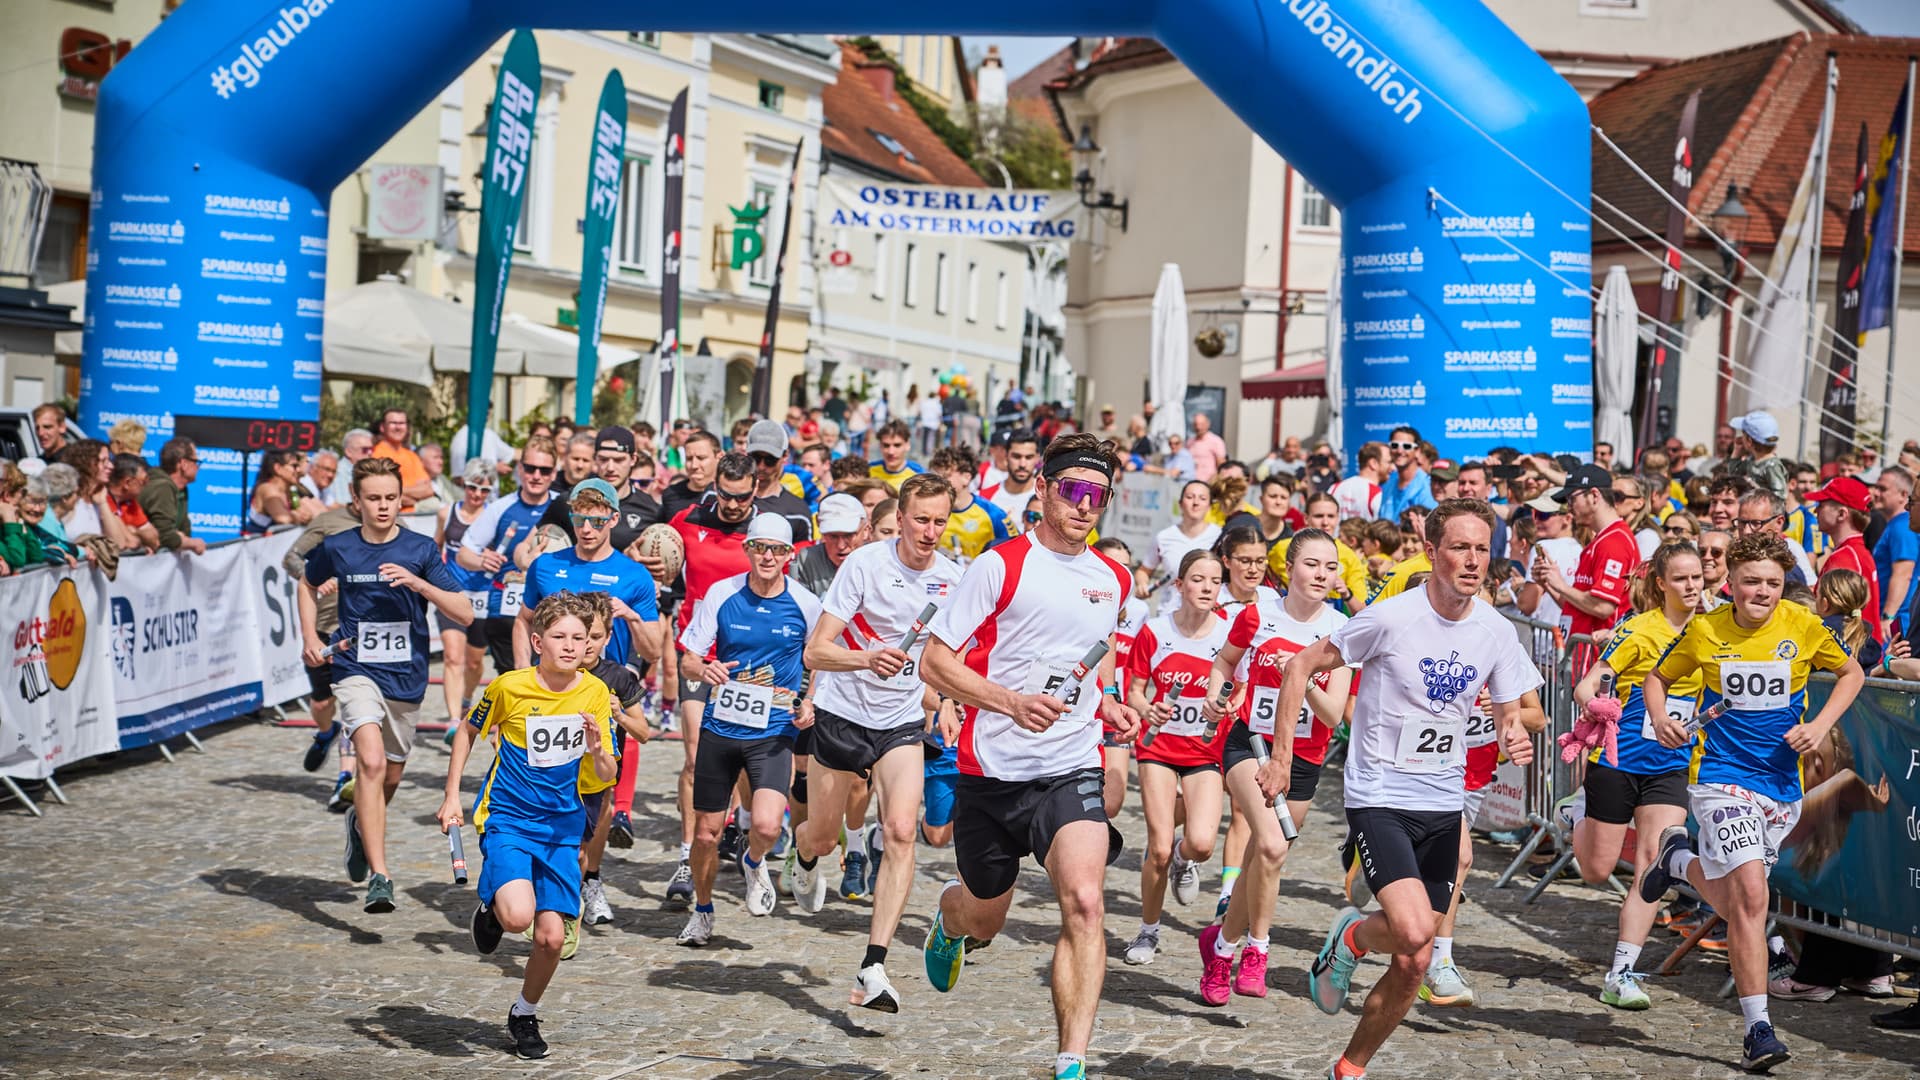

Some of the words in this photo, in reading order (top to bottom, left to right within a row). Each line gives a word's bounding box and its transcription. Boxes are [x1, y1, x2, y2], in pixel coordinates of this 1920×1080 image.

[205, 194, 278, 213] SPARKASSE
[860, 186, 1050, 213] OSTERLAUF
[109, 221, 170, 237] SPARKASSE
[831, 209, 869, 227] AM
[880, 213, 1075, 238] OSTERMONTAG
[1442, 217, 1521, 230] SPARKASSE
[201, 258, 275, 277] SPARKASSE
[1353, 252, 1409, 267] SPARKASSE
[106, 284, 167, 300] SPARKASSE
[1443, 284, 1522, 297] SPARKASSE
[198, 321, 272, 339] SPARKASSE
[1354, 320, 1410, 334] SPARKASSE
[102, 347, 163, 363] SPARKASSE
[1444, 351, 1523, 364] SPARKASSE
[194, 385, 268, 402] SPARKASSE
[1355, 385, 1411, 399] SPARKASSE
[1445, 417, 1524, 431] SPARKASSE
[247, 421, 317, 450] 0:03
[143, 608, 198, 653] SCHUSTER
[363, 632, 406, 651] 51a
[1726, 673, 1785, 696] 90a
[719, 688, 766, 716] 55a
[1256, 697, 1309, 725] 5a
[532, 727, 586, 753] 94a
[1416, 728, 1454, 753] 2a
[1718, 819, 1757, 841] OMV
[1357, 831, 1377, 879] RYZON
